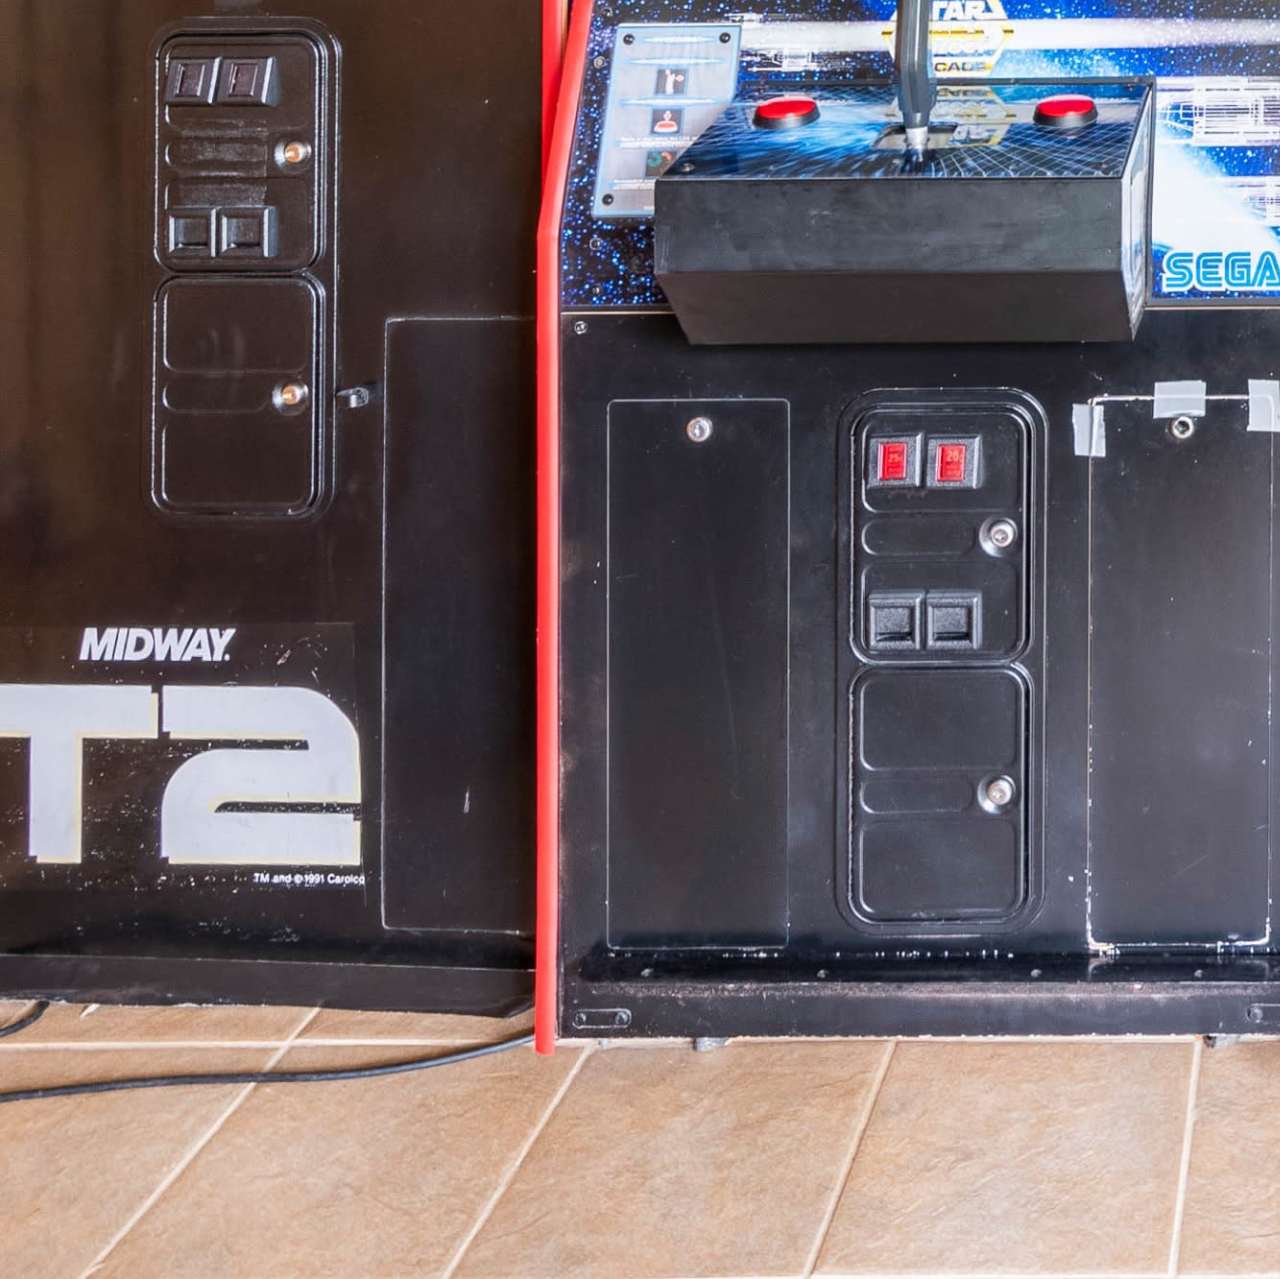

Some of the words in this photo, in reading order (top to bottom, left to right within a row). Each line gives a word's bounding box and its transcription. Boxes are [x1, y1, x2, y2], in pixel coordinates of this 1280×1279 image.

[0, 683, 362, 866] T2
[253, 872, 270, 884] TM
[272, 872, 292, 884] and
